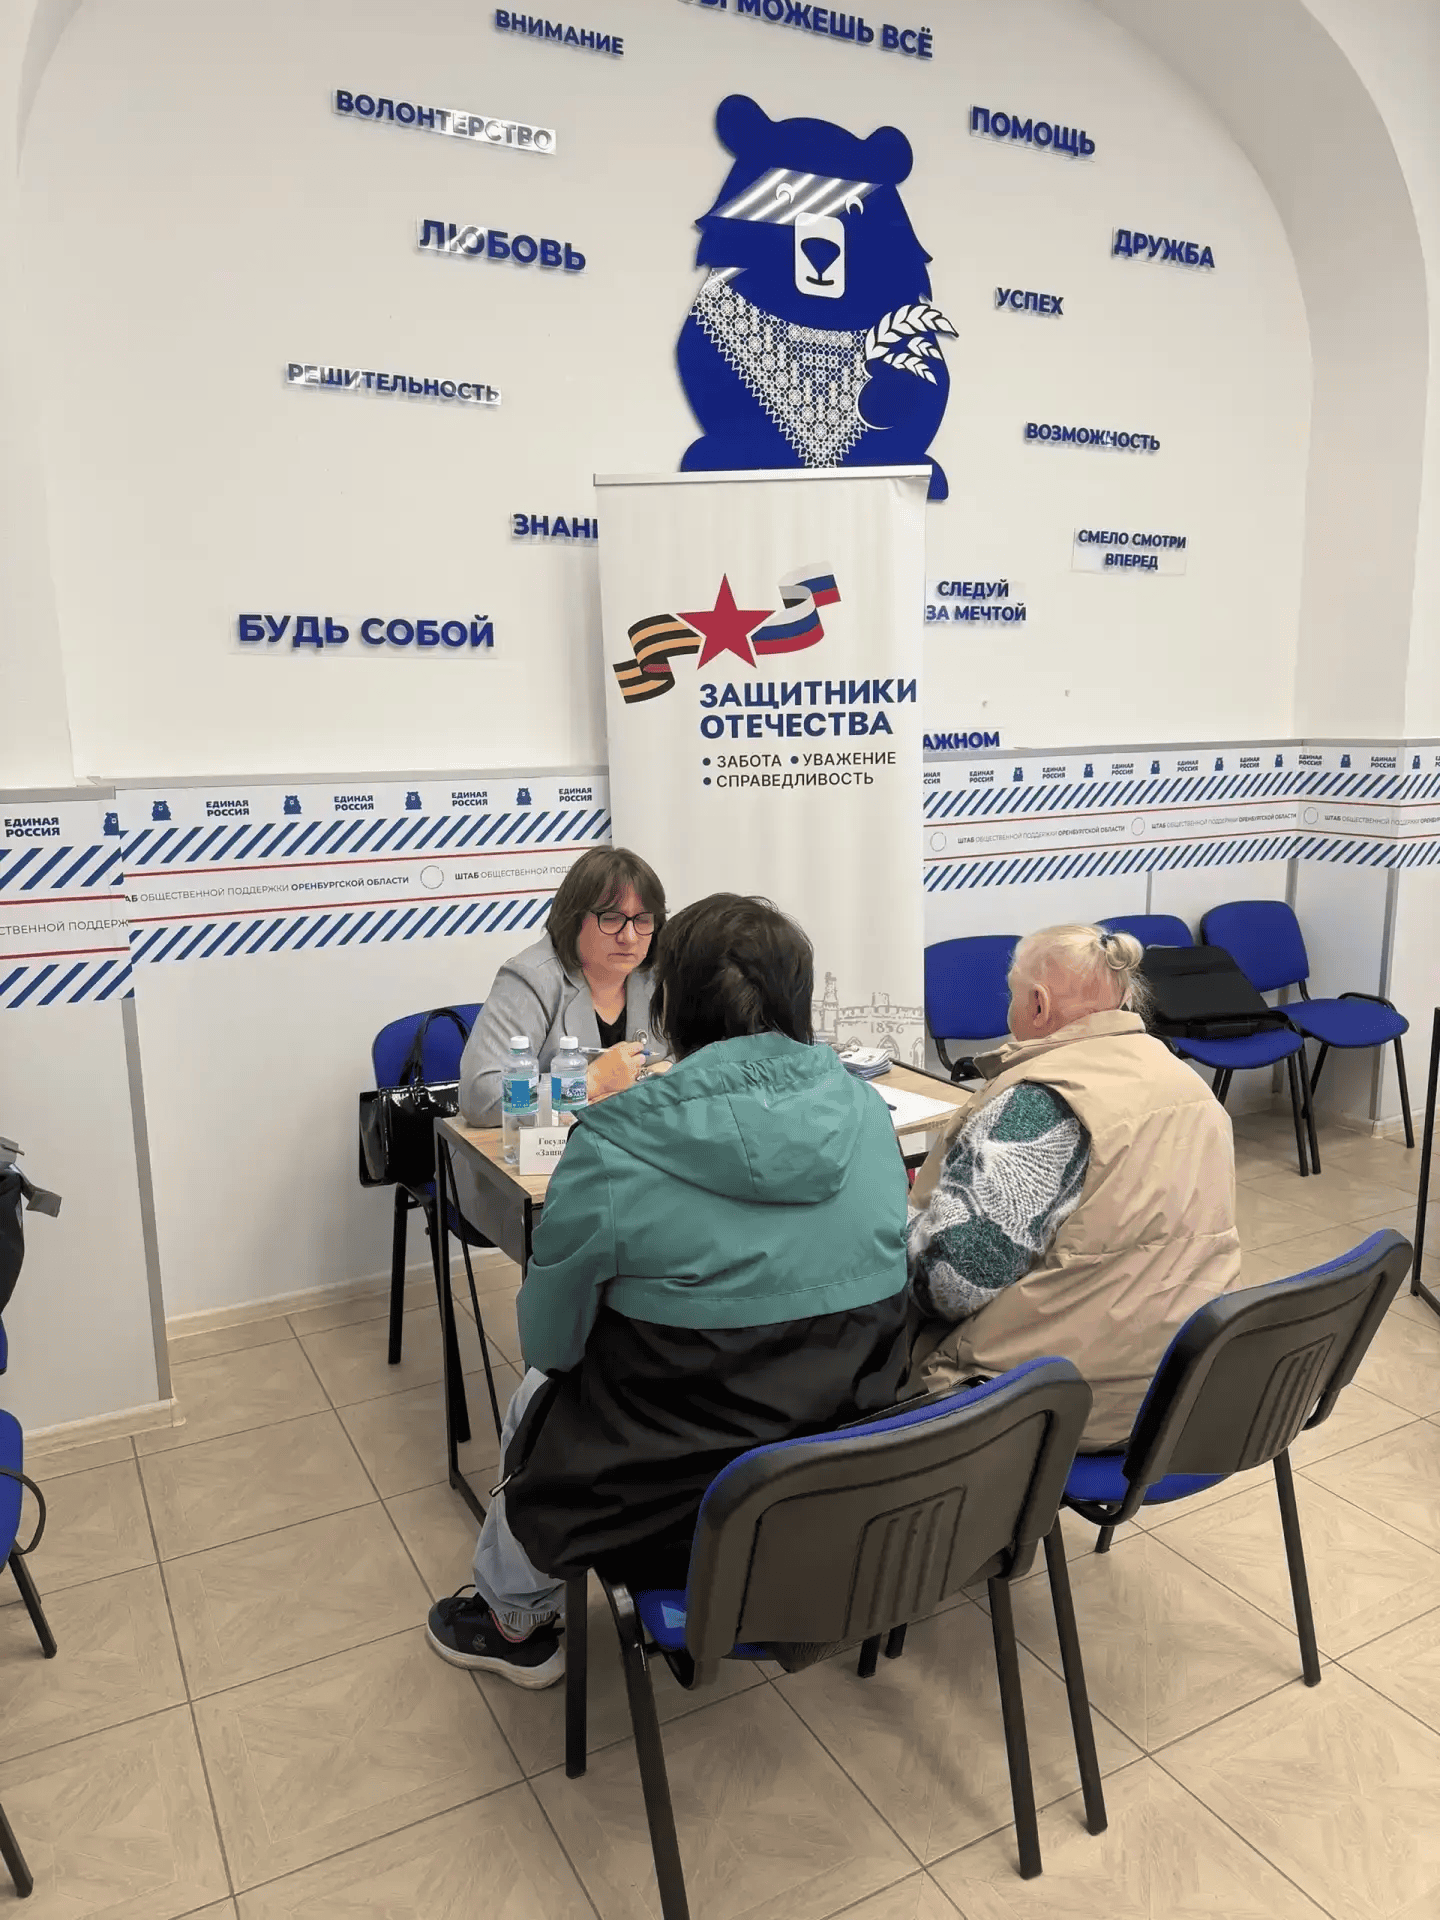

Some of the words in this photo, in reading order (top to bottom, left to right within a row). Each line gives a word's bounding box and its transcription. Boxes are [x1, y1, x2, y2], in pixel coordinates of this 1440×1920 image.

[495, 8, 624, 55] ВНИМАНИЕ
[737, 0, 875, 44] МОЖЕШЬ
[882, 24, 933, 58] ВСЁ
[336, 89, 553, 152] ВОЛОНТЕРСТВО
[971, 106, 1095, 157] ПОМОЩЬ
[419, 219, 586, 271] ЛЮБОВЬ
[1113, 229, 1215, 269] ДРУЖБА
[996, 288, 1064, 315] УСПЕХ
[288, 363, 500, 403] РЕШИТЕЛЬНОСТЬ
[1026, 423, 1160, 452] ВОЗМОЖНОСТЬ
[1078, 530, 1129, 546] СМЕЛО
[1132, 533, 1186, 549] СМОТРИ
[1105, 553, 1158, 570] ВПЕРЕД
[937, 579, 1009, 599] СЛЕДУЙ
[926, 605, 950, 621] ЗА
[954, 602, 1027, 622] МЕЧТОЙ
[238, 614, 350, 649] БУДЬ
[360, 614, 495, 648] СОБОЙ
[699, 679, 917, 709] ЗАЩИТНИКИ
[700, 711, 894, 739] ОТЕЧЕСТВА
[923, 731, 1000, 749] АЖНОМ
[716, 754, 783, 768] ЗАБОТА
[803, 752, 897, 767] УВАЖЕНИЕ
[716, 772, 874, 789] СПРАВЕДЛИВОСТЬ
[334, 795, 374, 804] ЕДИНАЯ
[452, 791, 488, 799] ЕДИНАЯ
[559, 787, 592, 795] ЕДИНАЯ
[206, 800, 249, 809] ЕДИНАЯ
[207, 808, 250, 817] РОССИЯ
[335, 803, 374, 811] РОССИЯ
[452, 799, 488, 807] РОССИЯ
[4, 817, 59, 827] ЕДИНАЯ
[1100, 825, 1125, 834] ОБЛАСТИ
[6, 827, 60, 837] РОССИЯ
[455, 871, 479, 880] ШТАБ
[480, 866, 548, 879] ОБЩЕСТВЕННОЙ
[140, 888, 225, 902] ОБЩЕСТВЕННОЙ
[228, 884, 289, 896] ПОДДЕРЖКИ
[291, 877, 365, 891] ОРЕНБУРГСКОЙ
[366, 876, 409, 887] ОБЛАСТИ
